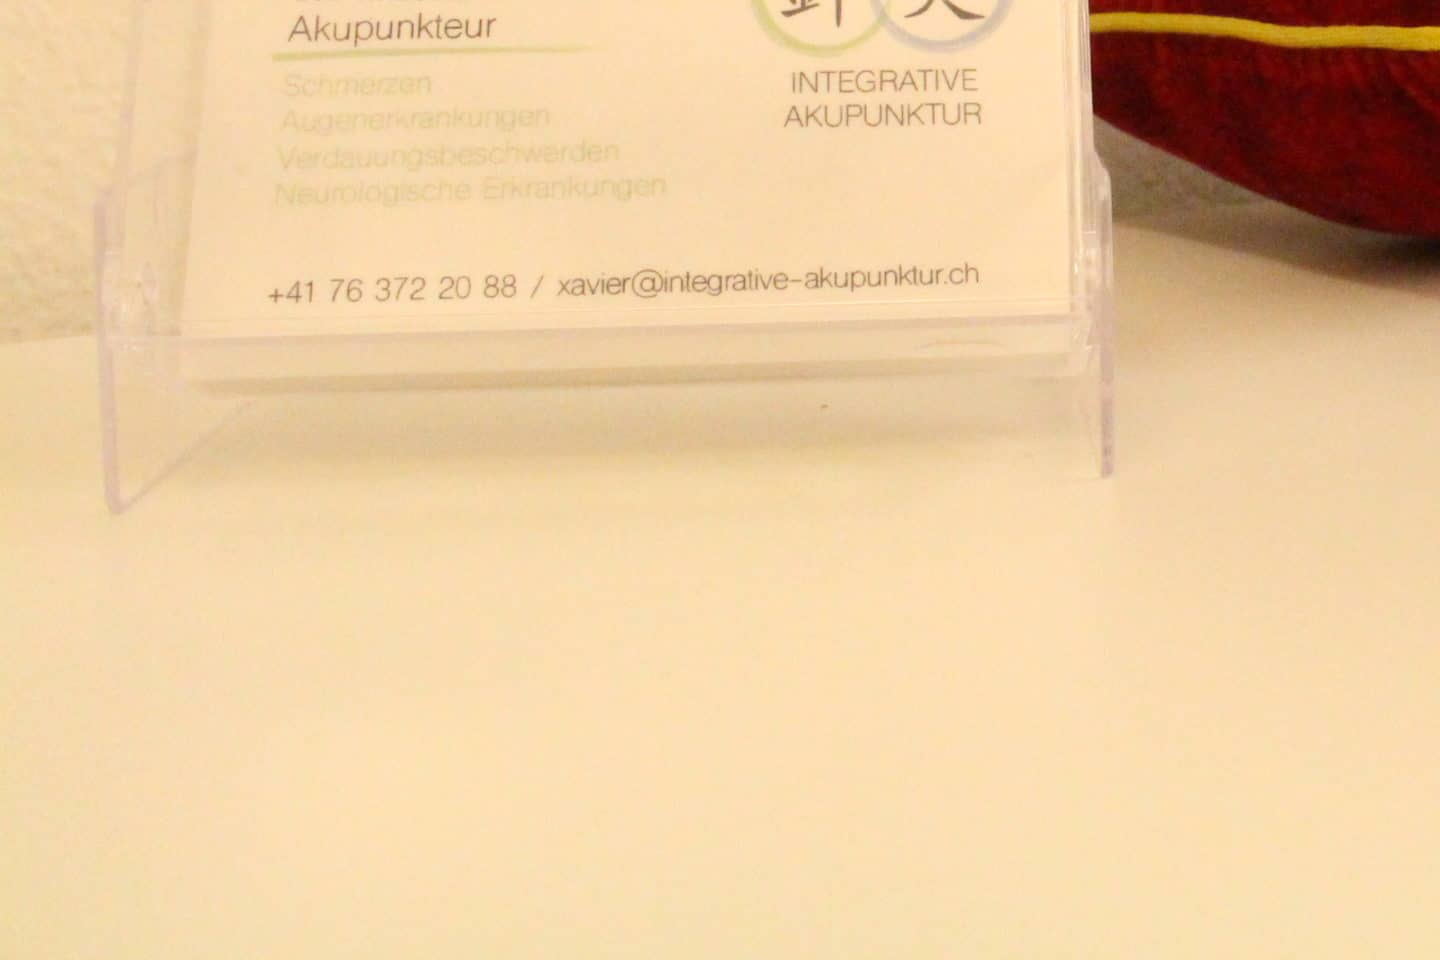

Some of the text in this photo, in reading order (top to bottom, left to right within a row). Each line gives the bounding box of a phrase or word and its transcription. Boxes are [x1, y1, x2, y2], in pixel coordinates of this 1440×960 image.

[287, 12, 497, 47] Akupunkteur
[283, 73, 432, 98] Schmerzen
[791, 68, 979, 94] INTEGRATIVE
[280, 108, 551, 137] Augenerkrankungen
[783, 102, 982, 129] AKUPUNKTUR
[277, 140, 620, 173] Verdauungsbeschwerden
[273, 175, 667, 209] Neurologische Erkrankungen
[268, 262, 980, 304] +41 76 372 20 88 / xavier@integrative-akupunktur.ch
